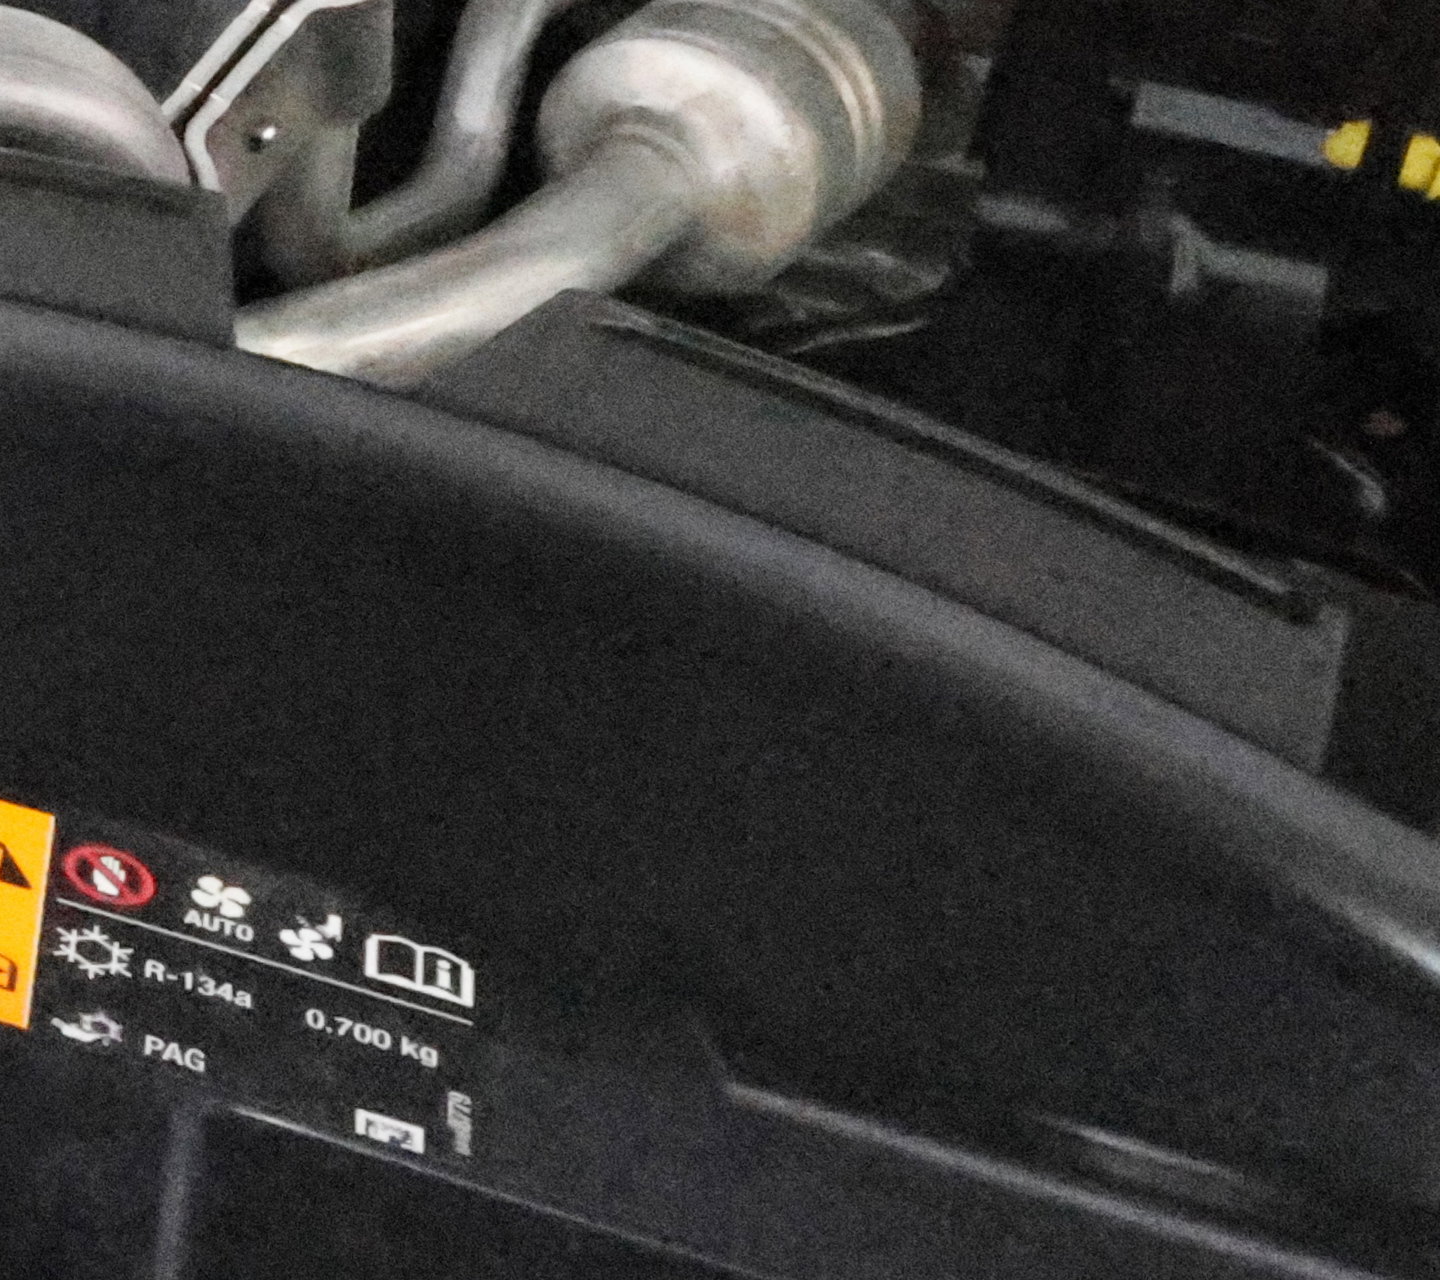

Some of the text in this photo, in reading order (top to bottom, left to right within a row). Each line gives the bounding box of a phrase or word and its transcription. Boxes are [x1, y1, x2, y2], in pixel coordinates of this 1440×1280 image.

[183, 910, 255, 943] AUTO
[142, 957, 440, 1069] R-134a 0.700 kg
[142, 1033, 207, 1074] PAG
